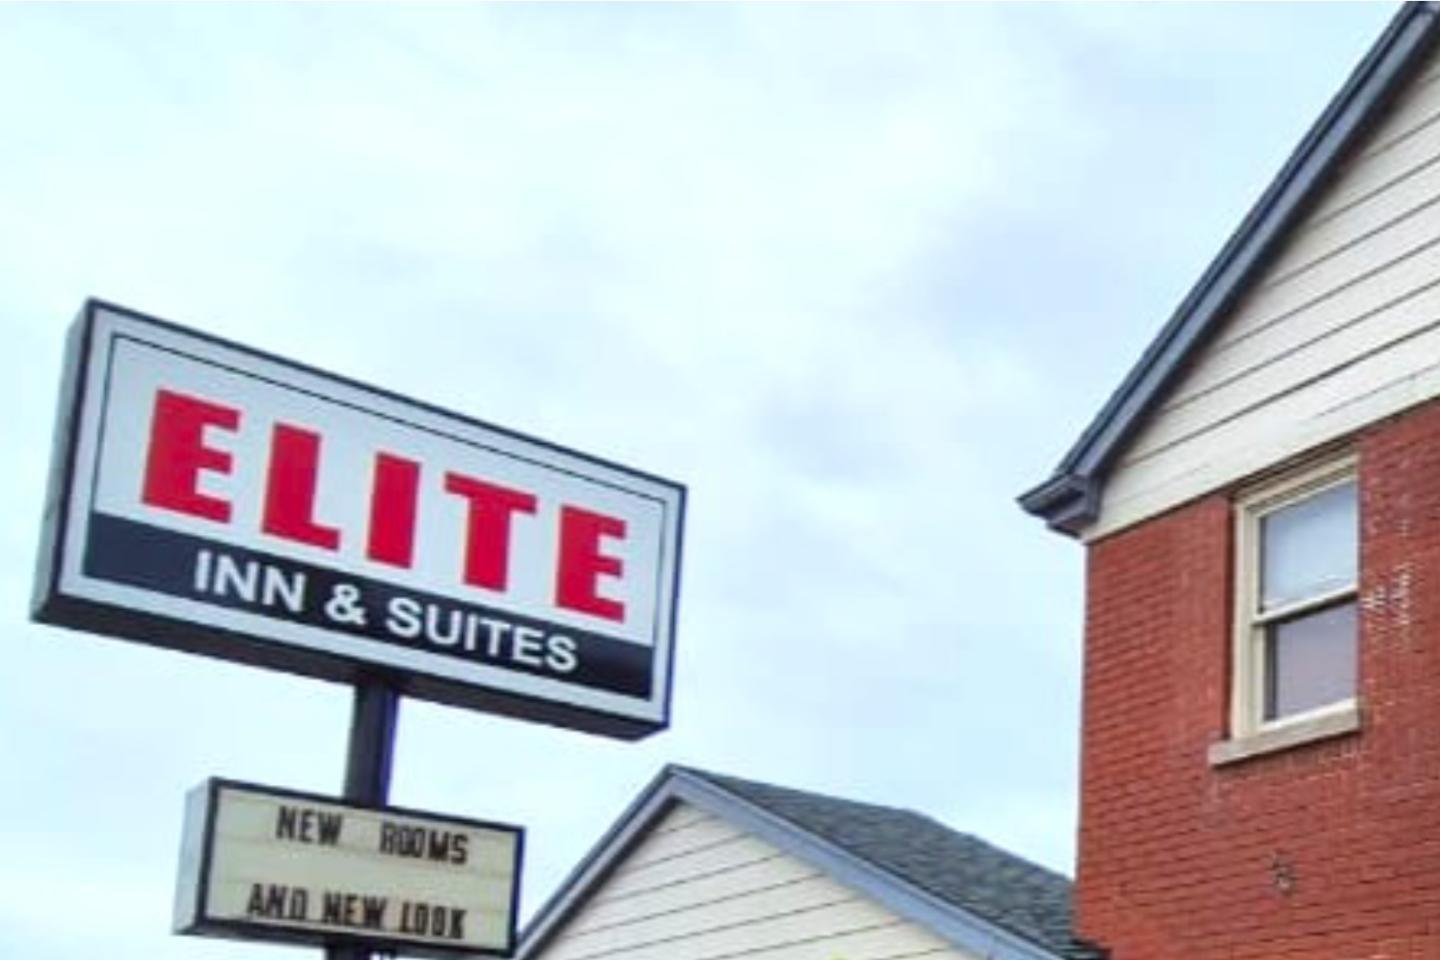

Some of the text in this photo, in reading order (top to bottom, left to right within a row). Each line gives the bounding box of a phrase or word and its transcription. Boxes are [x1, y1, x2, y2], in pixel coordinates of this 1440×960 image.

[141, 388, 627, 623] ELITE
[194, 550, 578, 671] INN & SUITES
[276, 806, 469, 865] NEW ROOMS
[247, 883, 467, 939] AND NEW LOOK
